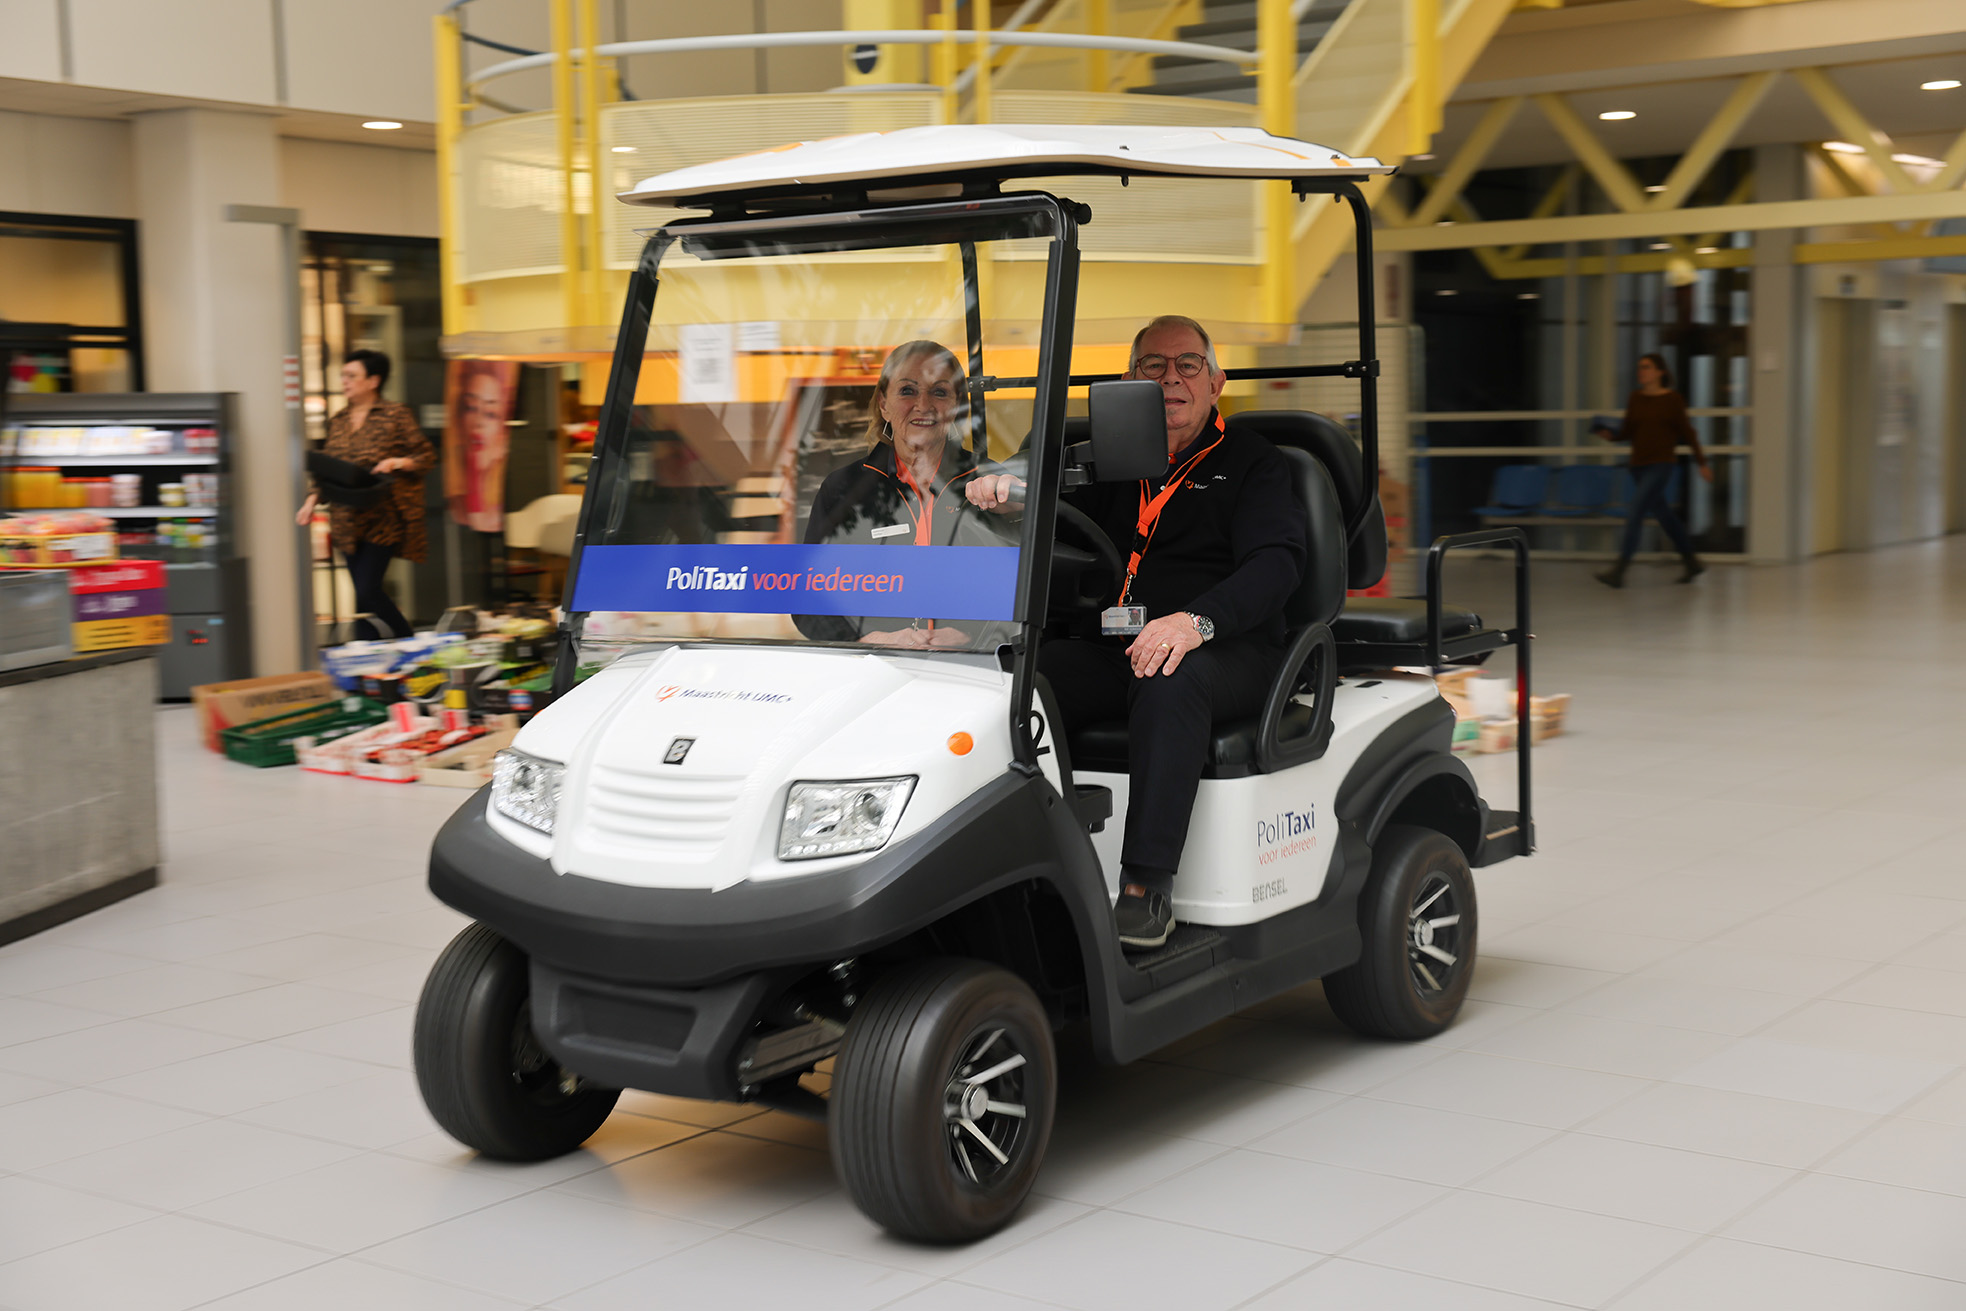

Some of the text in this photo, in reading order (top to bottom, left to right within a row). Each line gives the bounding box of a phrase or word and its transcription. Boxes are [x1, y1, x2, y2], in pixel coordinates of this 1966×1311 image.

[666, 565, 904, 593] PoliTaxi voor iedereen
[1257, 802, 1315, 847] PoliTaxi
[1258, 835, 1317, 866] voor iedereen
[1251, 877, 1288, 903] BENSEL
